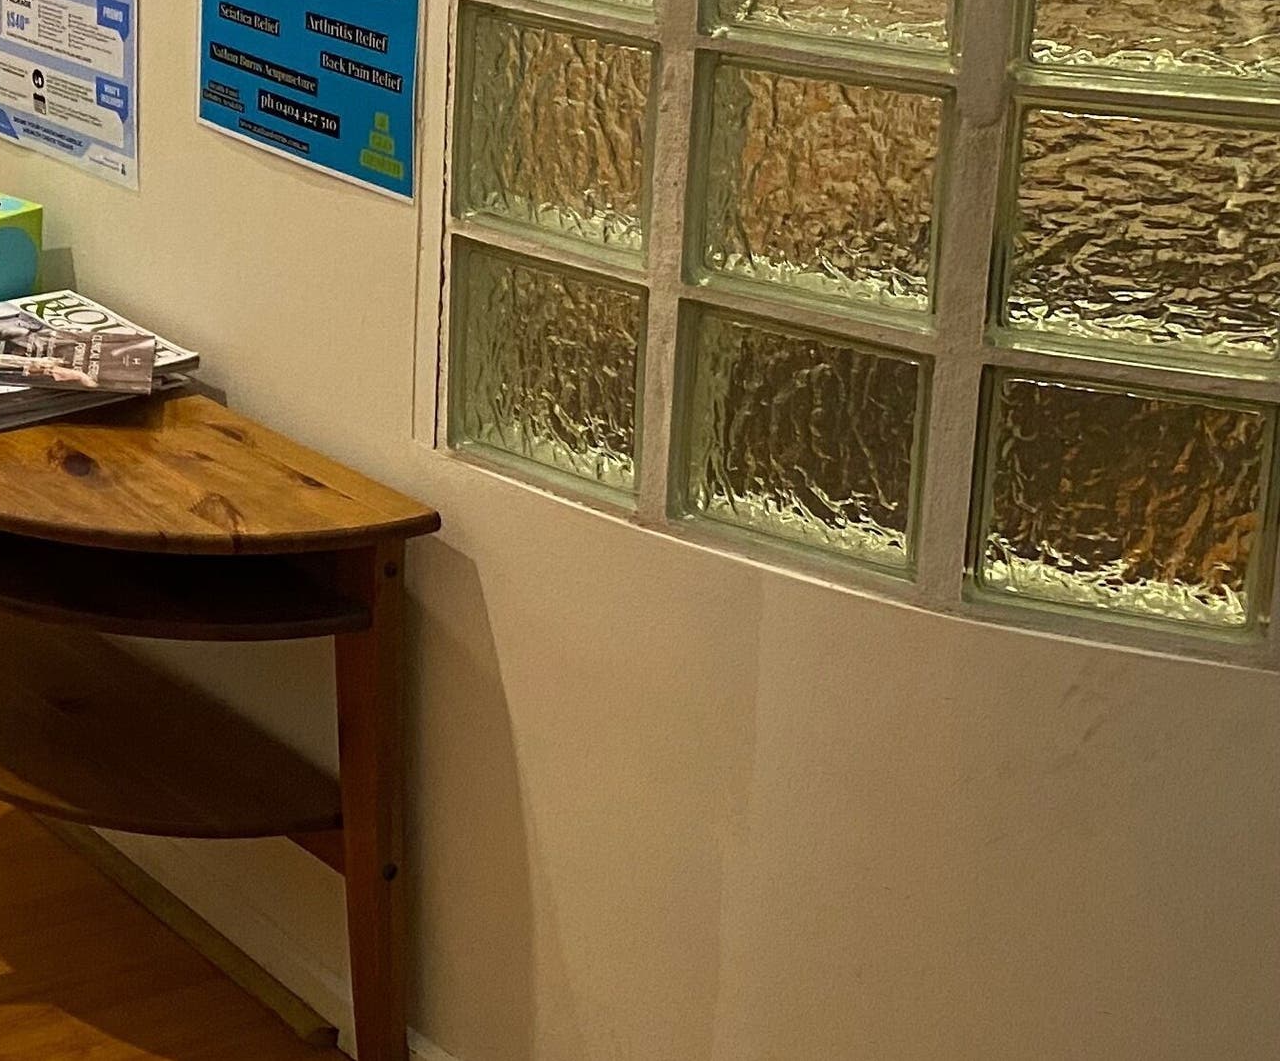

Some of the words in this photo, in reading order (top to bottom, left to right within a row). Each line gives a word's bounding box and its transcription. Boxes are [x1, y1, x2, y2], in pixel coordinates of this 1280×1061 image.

[220, 3, 253, 26] Sciatica
[254, 13, 280, 35] Relief
[307, 15, 353, 41] Arthritis
[355, 28, 388, 52] Relief
[322, 53, 347, 74] Back
[348, 61, 371, 82] Pain
[372, 69, 403, 93] Relief
[260, 93, 275, 110] ph
[275, 100, 301, 122] 0404
[301, 108, 320, 129] 427
[320, 116, 338, 133] 510
[90, 334, 103, 361] CLINICAL
